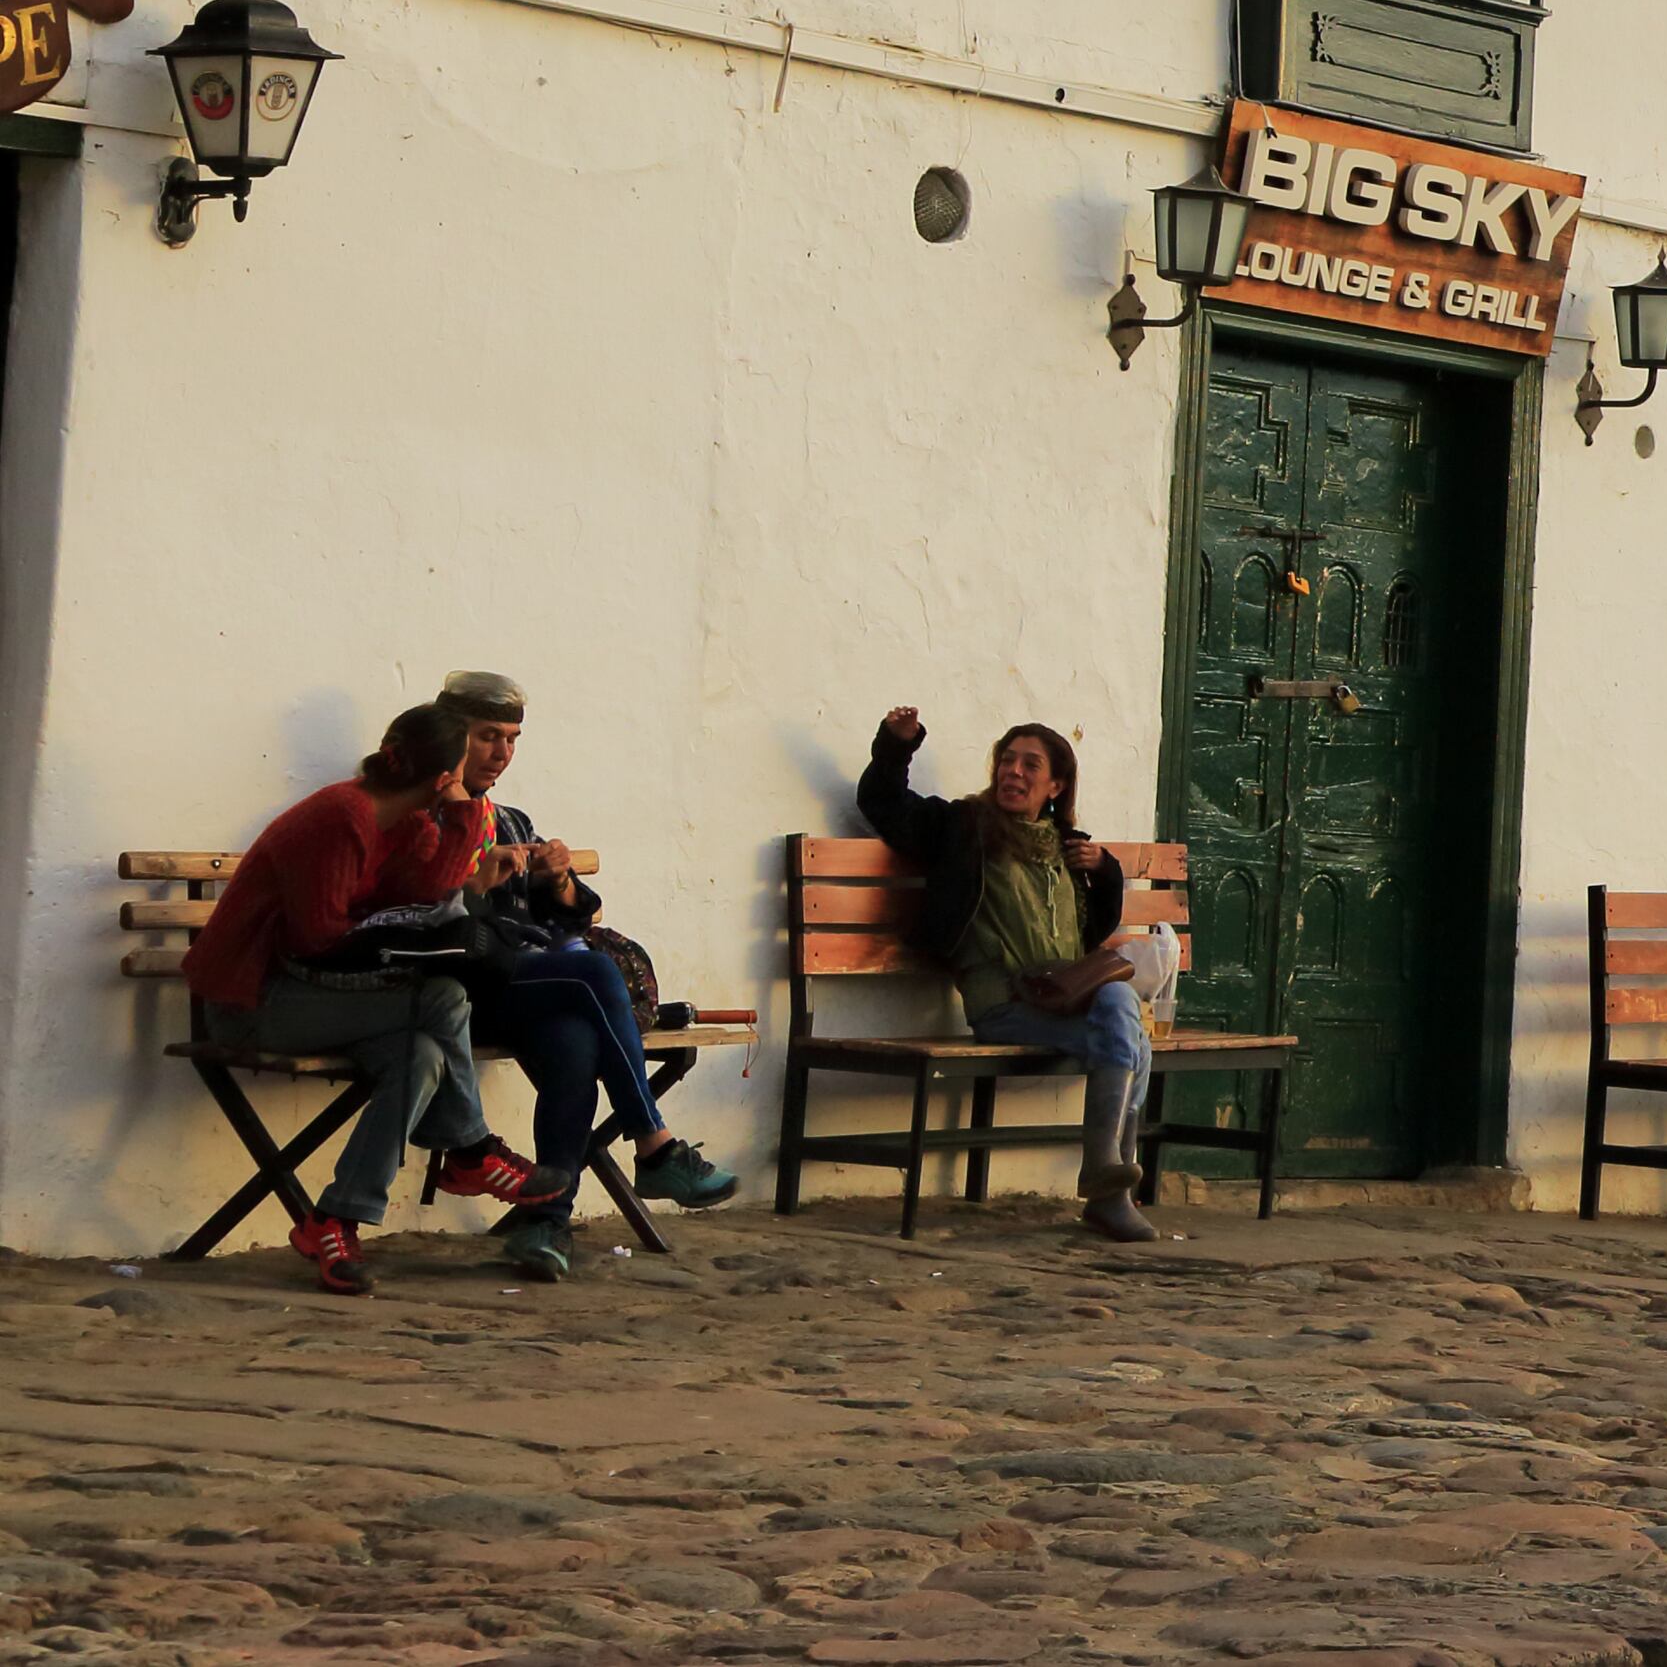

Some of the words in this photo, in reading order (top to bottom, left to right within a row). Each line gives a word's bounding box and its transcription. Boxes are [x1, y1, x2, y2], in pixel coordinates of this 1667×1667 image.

[1241, 130, 1397, 226] BIG
[1401, 164, 1582, 261] SKY
[1235, 242, 1394, 303] OUNGE
[1402, 272, 1431, 310] &
[1443, 279, 1547, 332] GRILL
